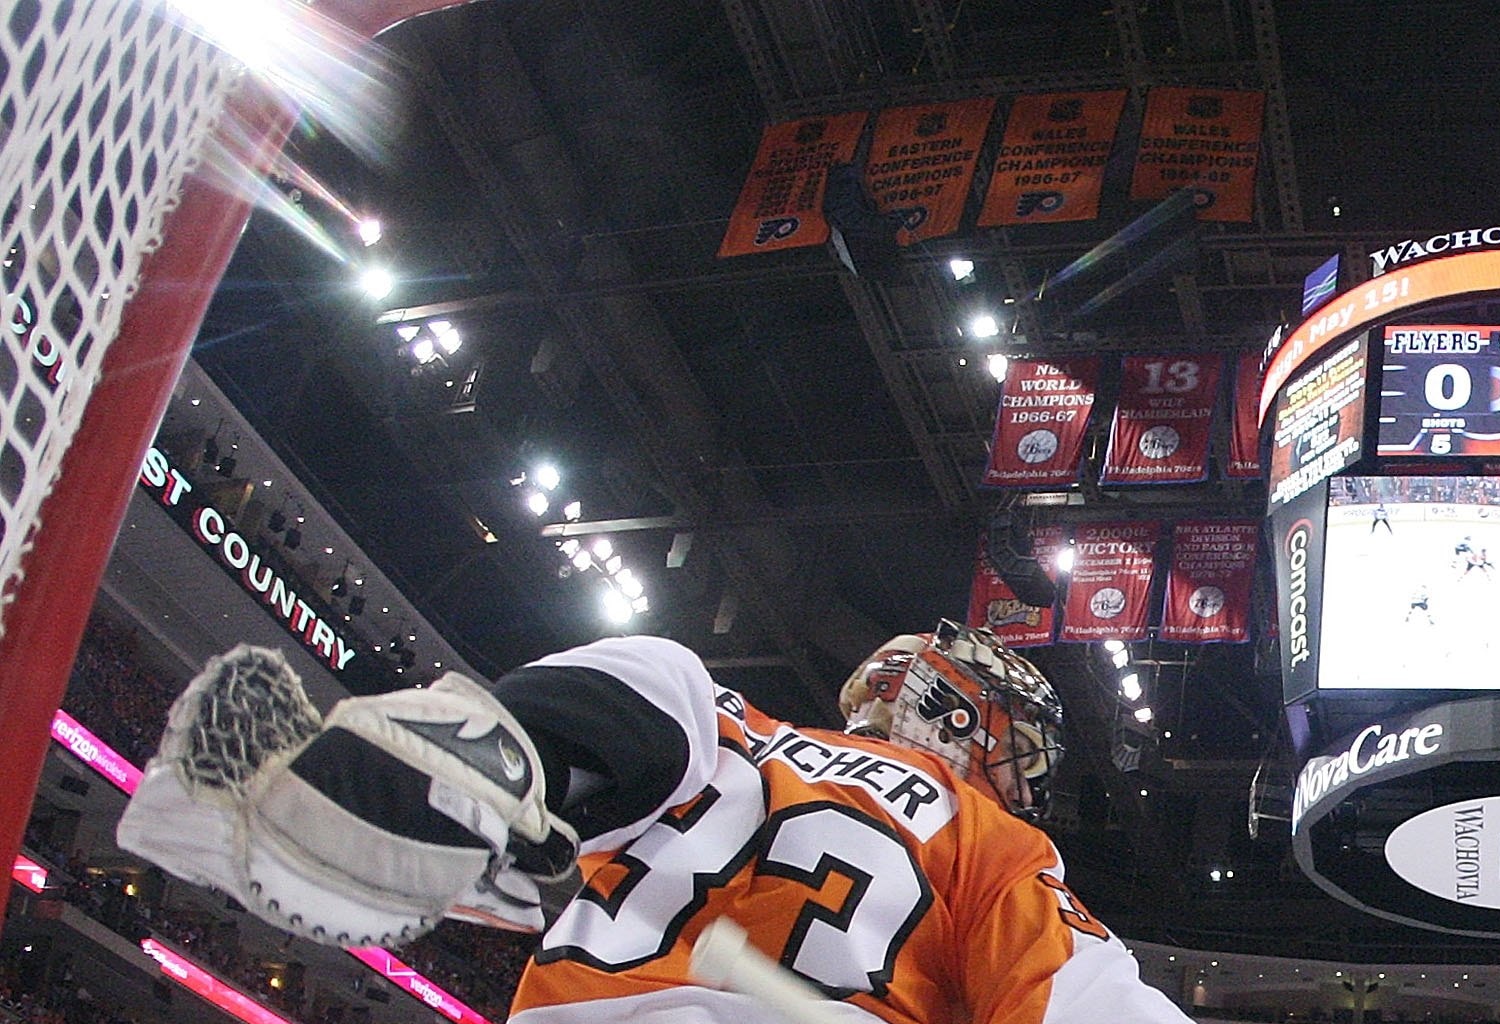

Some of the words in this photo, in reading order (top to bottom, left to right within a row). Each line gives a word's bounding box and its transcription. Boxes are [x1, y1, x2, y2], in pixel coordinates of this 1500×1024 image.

[1032, 127, 1087, 141] WALES
[1173, 124, 1231, 137] WALES
[889, 138, 962, 157] EASTERN
[1002, 141, 1111, 158] CONFERENCE
[869, 151, 974, 176] CONFERENCE
[998, 155, 1107, 172] CHAMPIONS
[1139, 153, 1257, 170] CHAMPIONS
[872, 166, 963, 191] CHAMPIONS
[1309, 304, 1355, 344] May
[1364, 276, 1410, 310] 15!
[1391, 330, 1482, 353] FLYERS
[1021, 379, 1082, 391] WORLD
[1143, 360, 1200, 394] 13
[1424, 363, 1472, 412] 0
[1002, 393, 1095, 408] CHAMPIONS
[1010, 410, 1077, 424] 1966-67
[1430, 433, 1452, 455] 5
[1108, 465, 1173, 475] Philadelphia
[1086, 526, 1149, 541] 2,000th
[1202, 525, 1258, 534] ATLANTIC
[1191, 534, 1241, 543] DIVISION
[1075, 541, 1156, 555] VICTORY
[199, 507, 355, 670] COUNTRY
[1065, 625, 1119, 635] Philadelphia
[1297, 723, 1443, 812] NovaCare
[1454, 804, 1484, 901] WACHOVIA
